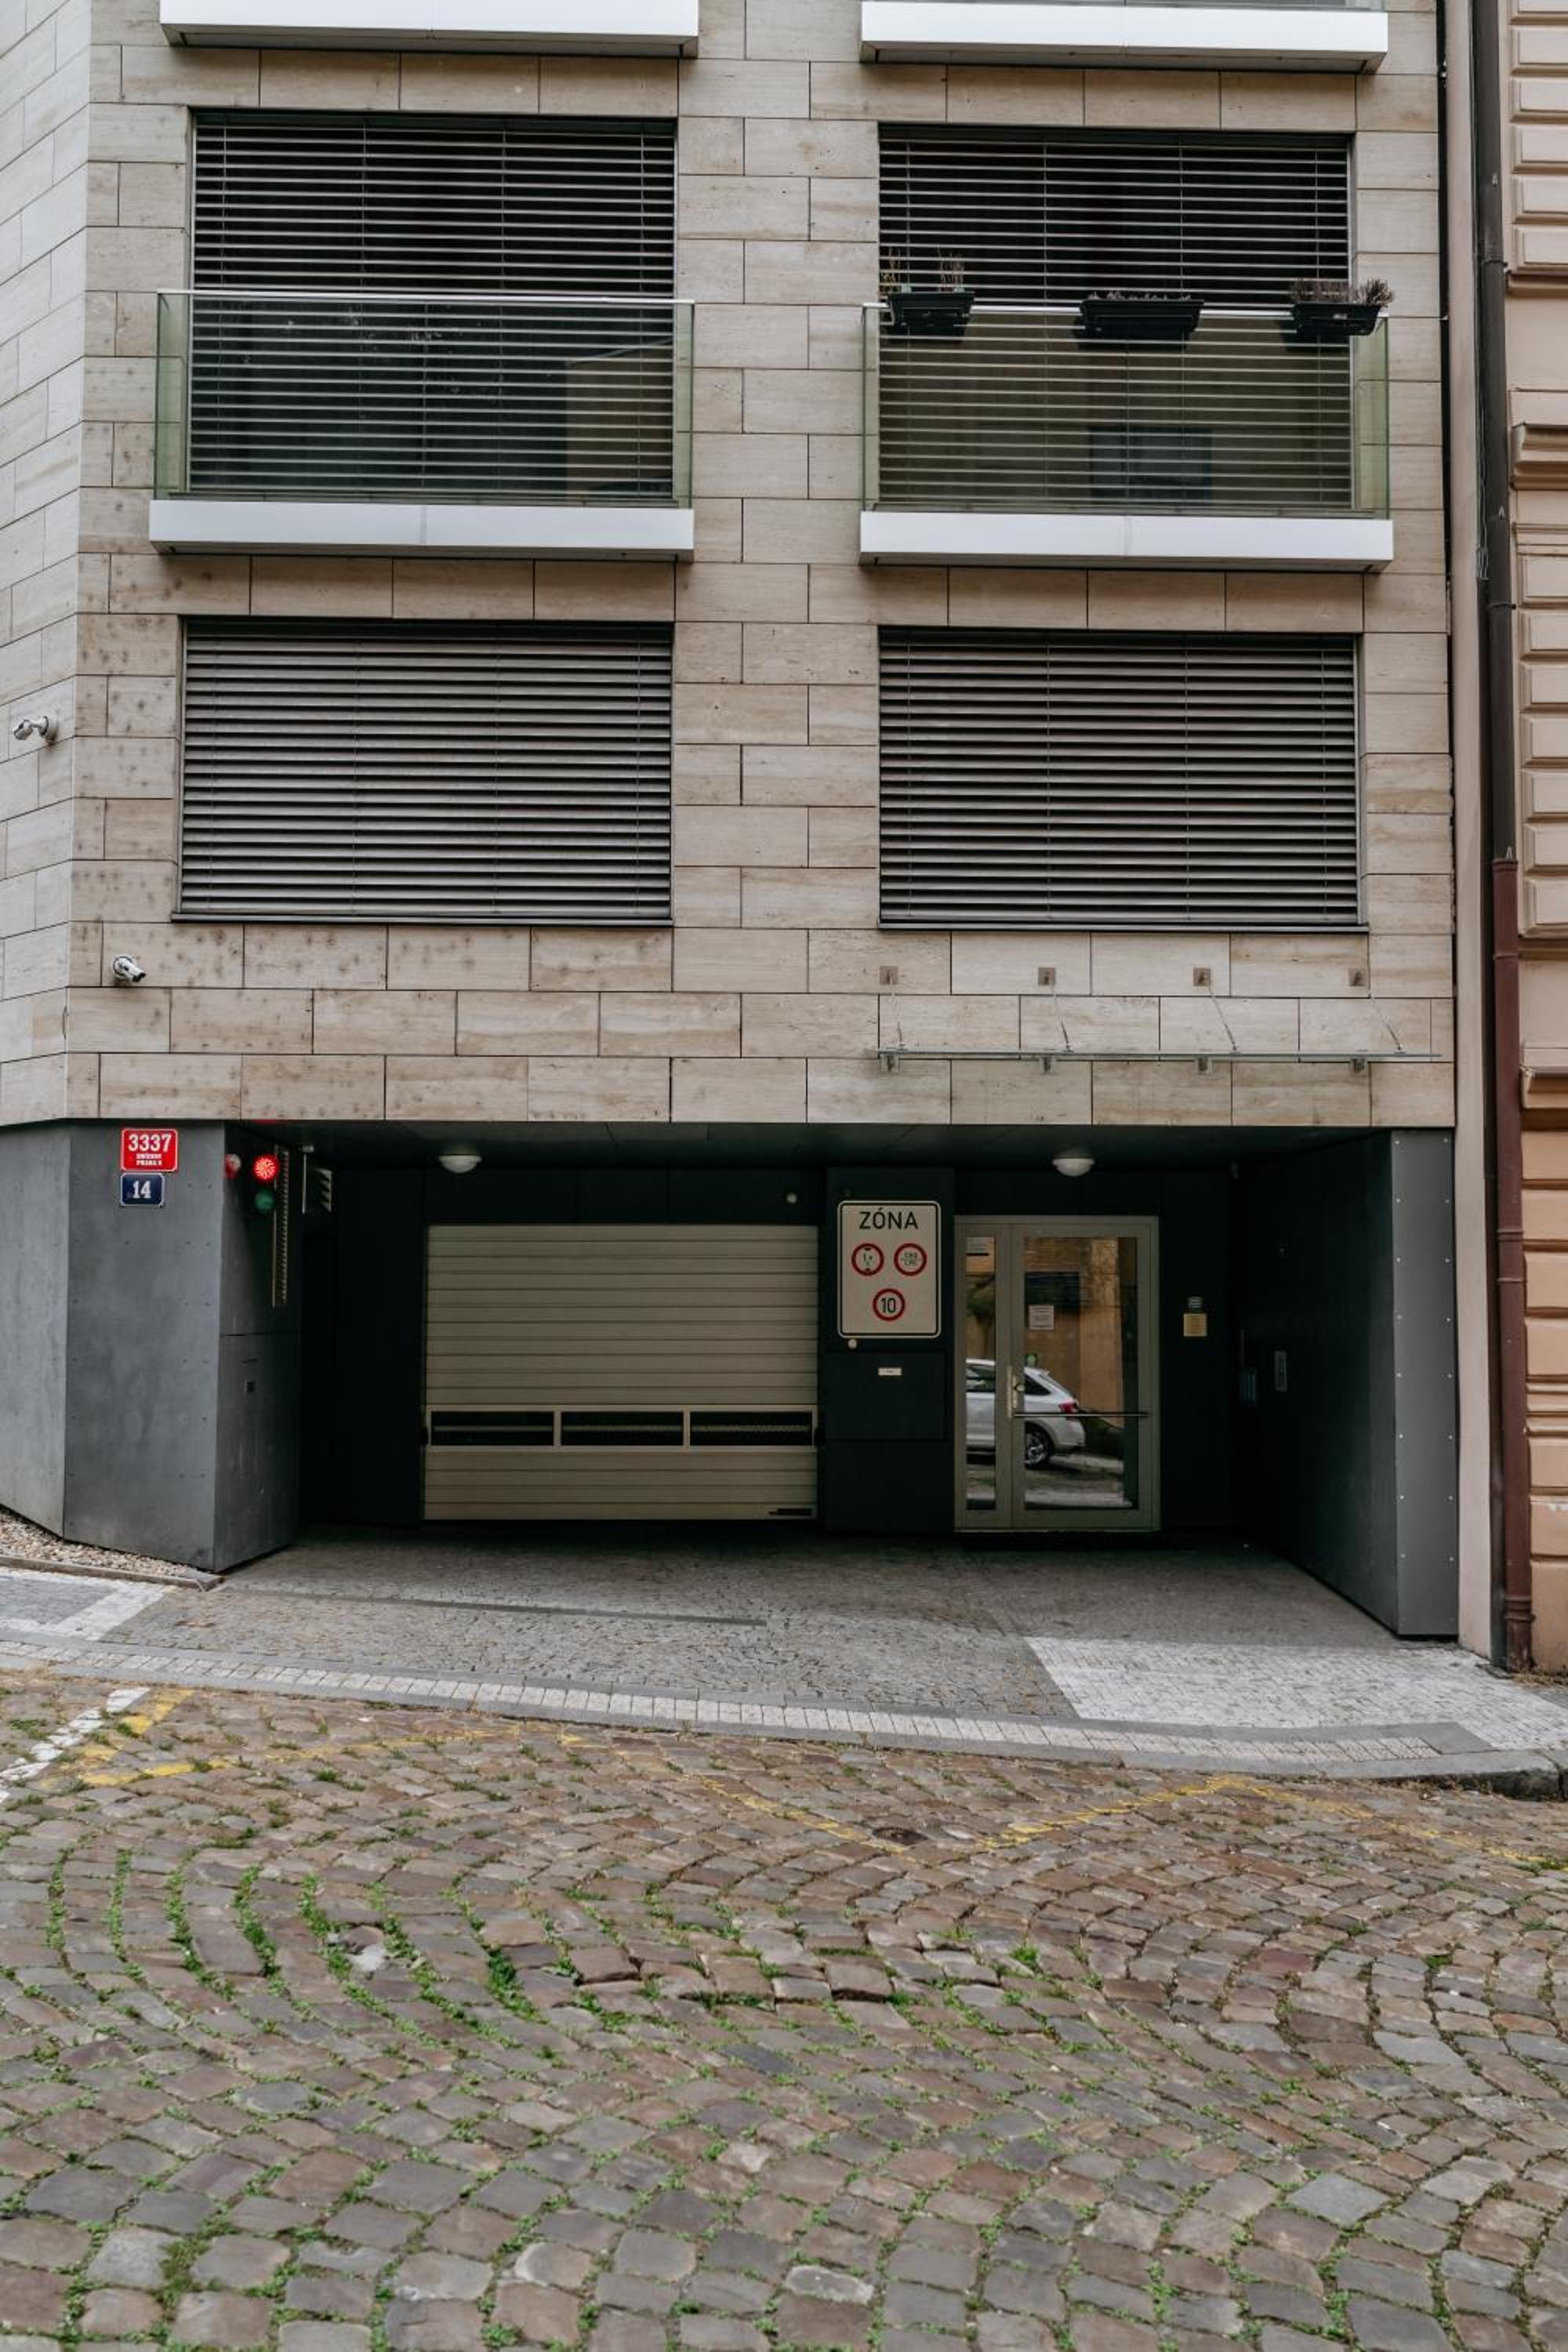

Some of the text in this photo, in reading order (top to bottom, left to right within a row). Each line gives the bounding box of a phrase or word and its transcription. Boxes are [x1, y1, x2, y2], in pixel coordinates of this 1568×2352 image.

[128, 1134, 172, 1152] 3337
[132, 1180, 151, 1199] 14
[858, 1207, 919, 1230] ZÓNA
[880, 1298, 896, 1313] 10
